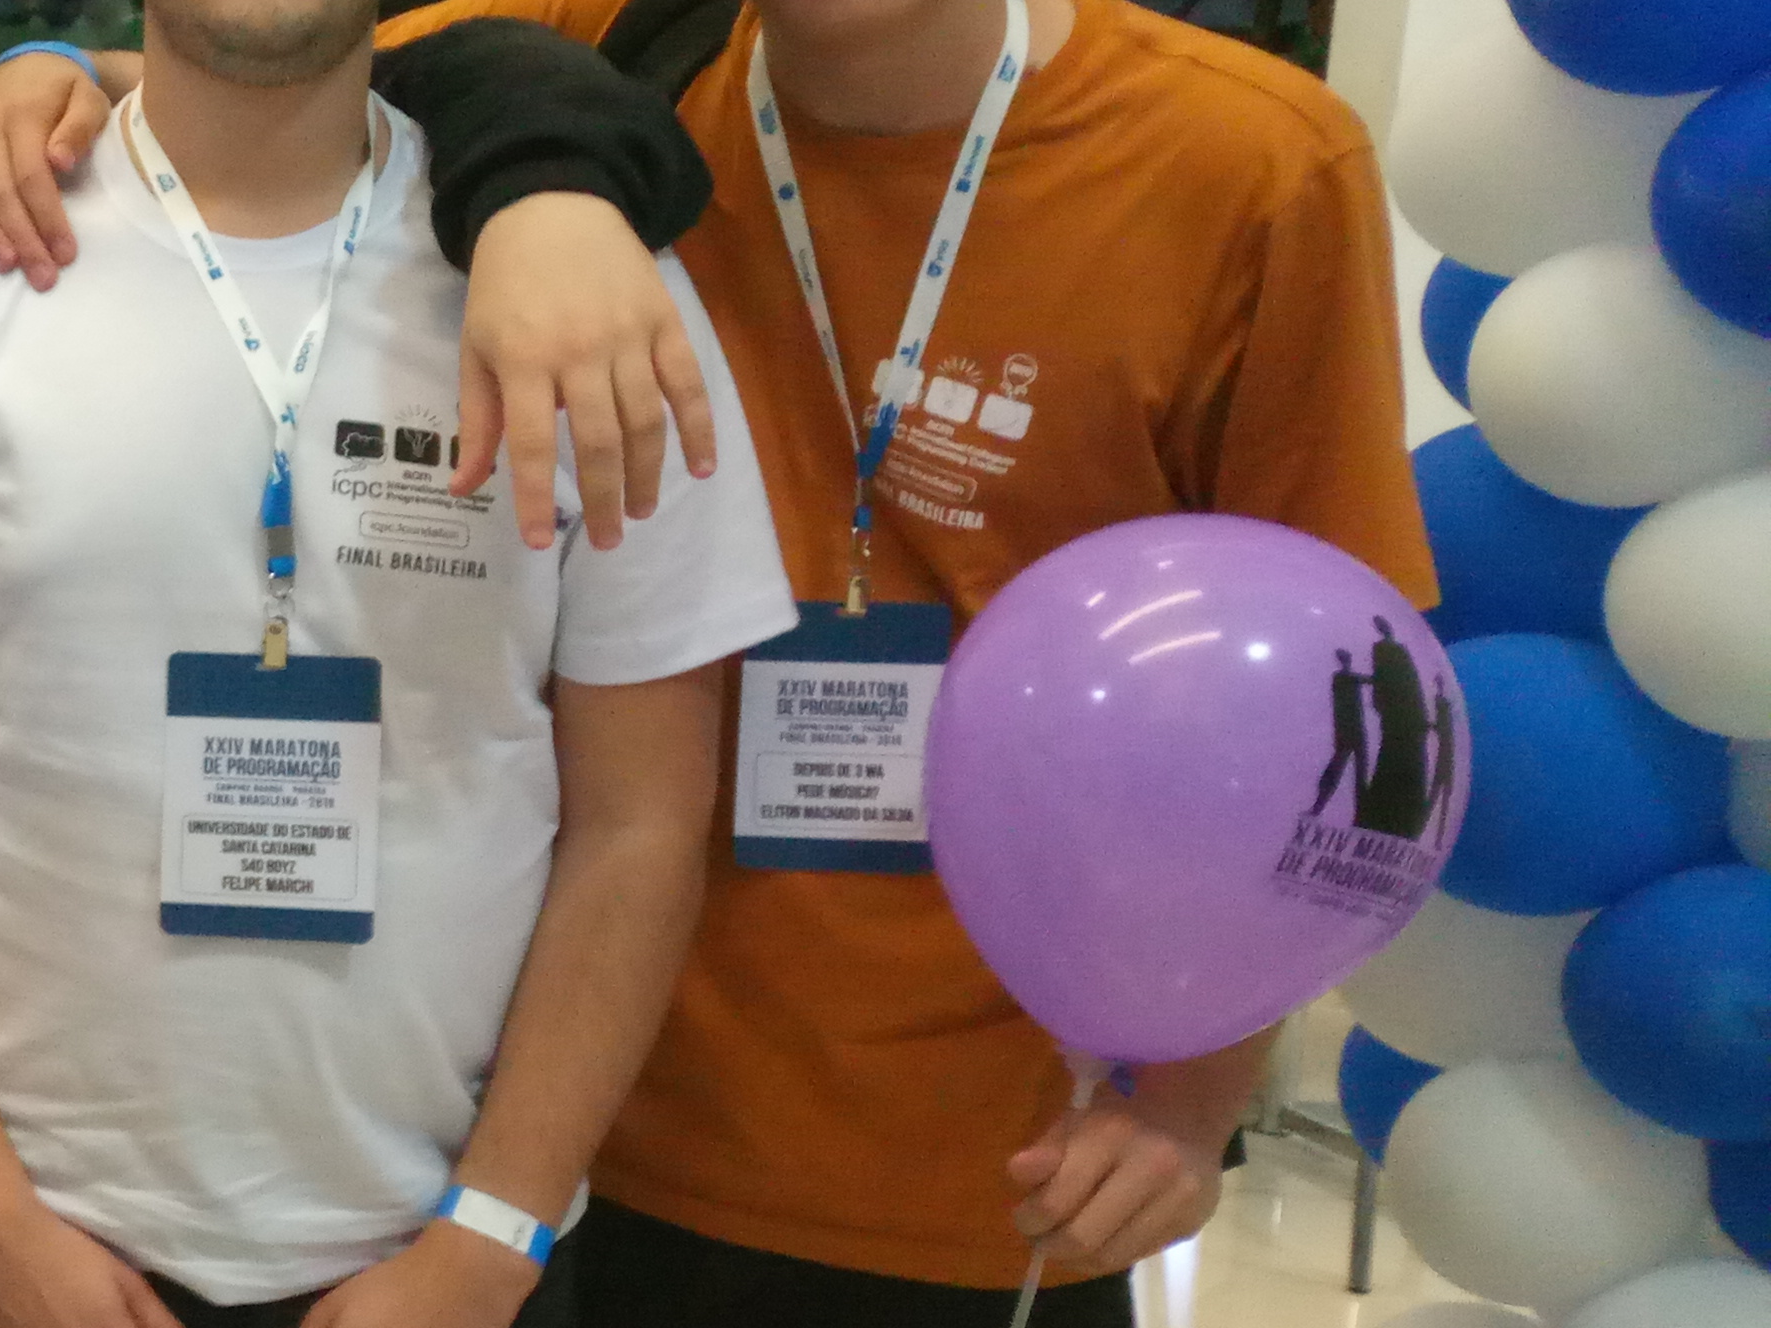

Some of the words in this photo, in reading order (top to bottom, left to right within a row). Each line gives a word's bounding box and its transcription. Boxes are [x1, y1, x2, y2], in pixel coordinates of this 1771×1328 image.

[332, 478, 382, 500] icpc
[899, 490, 985, 530] BRASILEIRA
[336, 545, 384, 569] FINAL
[390, 551, 488, 579] BRASILEIRA
[777, 679, 817, 697] XXIV
[821, 679, 909, 698] MARATONA
[203, 736, 244, 755] XXIV
[250, 738, 341, 760] MARATONA
[202, 757, 223, 774] DE
[227, 757, 341, 782] PROGRAMAÇÃO
[187, 820, 268, 837] UNIVERSIDADE
[272, 823, 289, 837] DO
[291, 823, 334, 840] ESTADO
[336, 825, 352, 840] DE
[221, 839, 258, 854] SANTA
[261, 840, 317, 856] CATARINA
[222, 875, 262, 892] FELIPE
[266, 877, 315, 894] MARCHI
